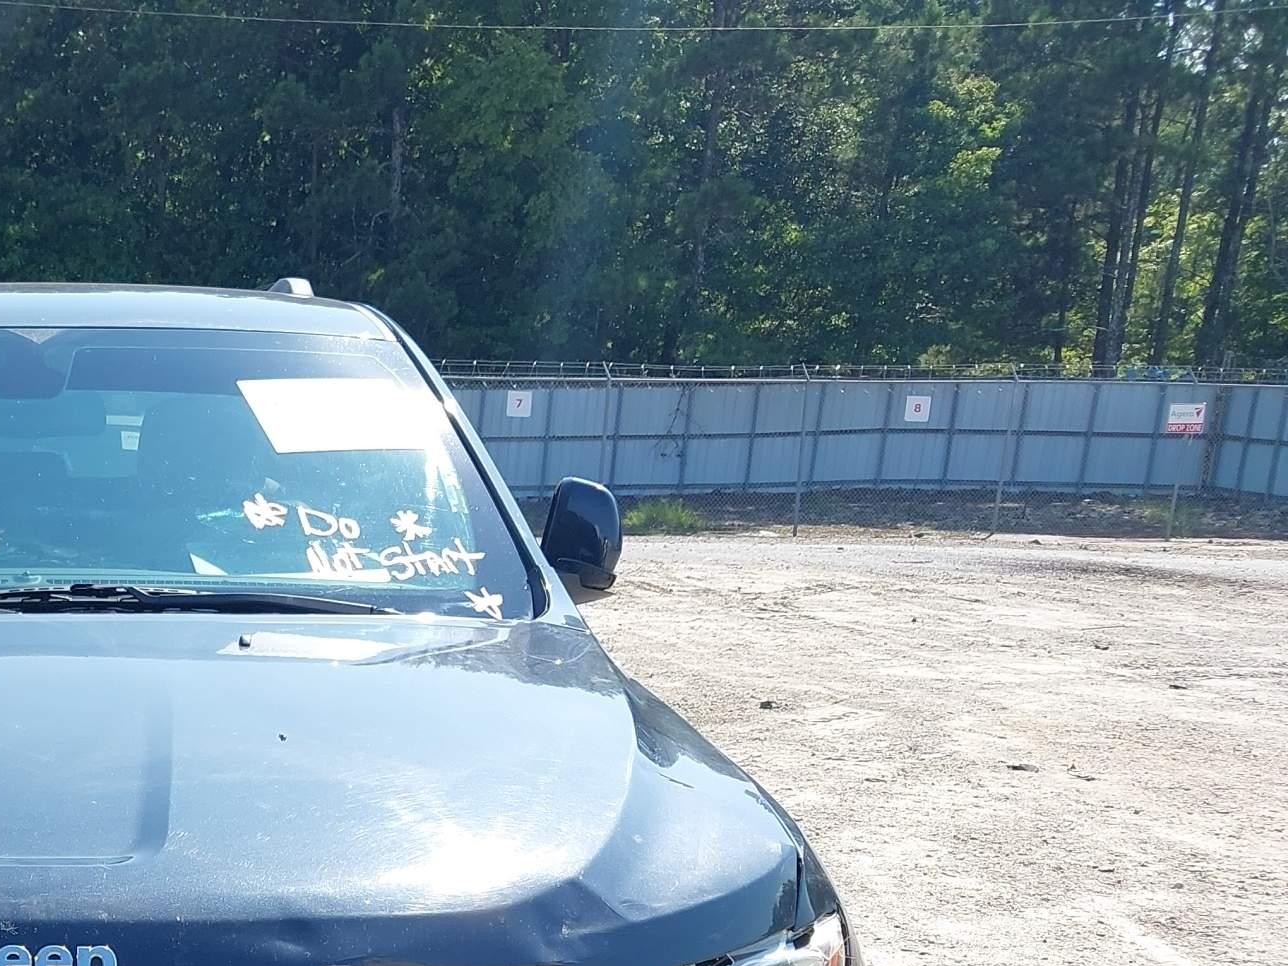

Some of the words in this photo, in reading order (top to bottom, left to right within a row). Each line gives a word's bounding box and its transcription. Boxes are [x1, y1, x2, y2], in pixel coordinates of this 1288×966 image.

[515, 398, 523, 408] 7
[914, 403, 921, 413] 8
[1168, 424, 1185, 432] DROP
[1186, 424, 1202, 432] ZONE
[297, 504, 361, 539] Do
[306, 541, 372, 575] Not
